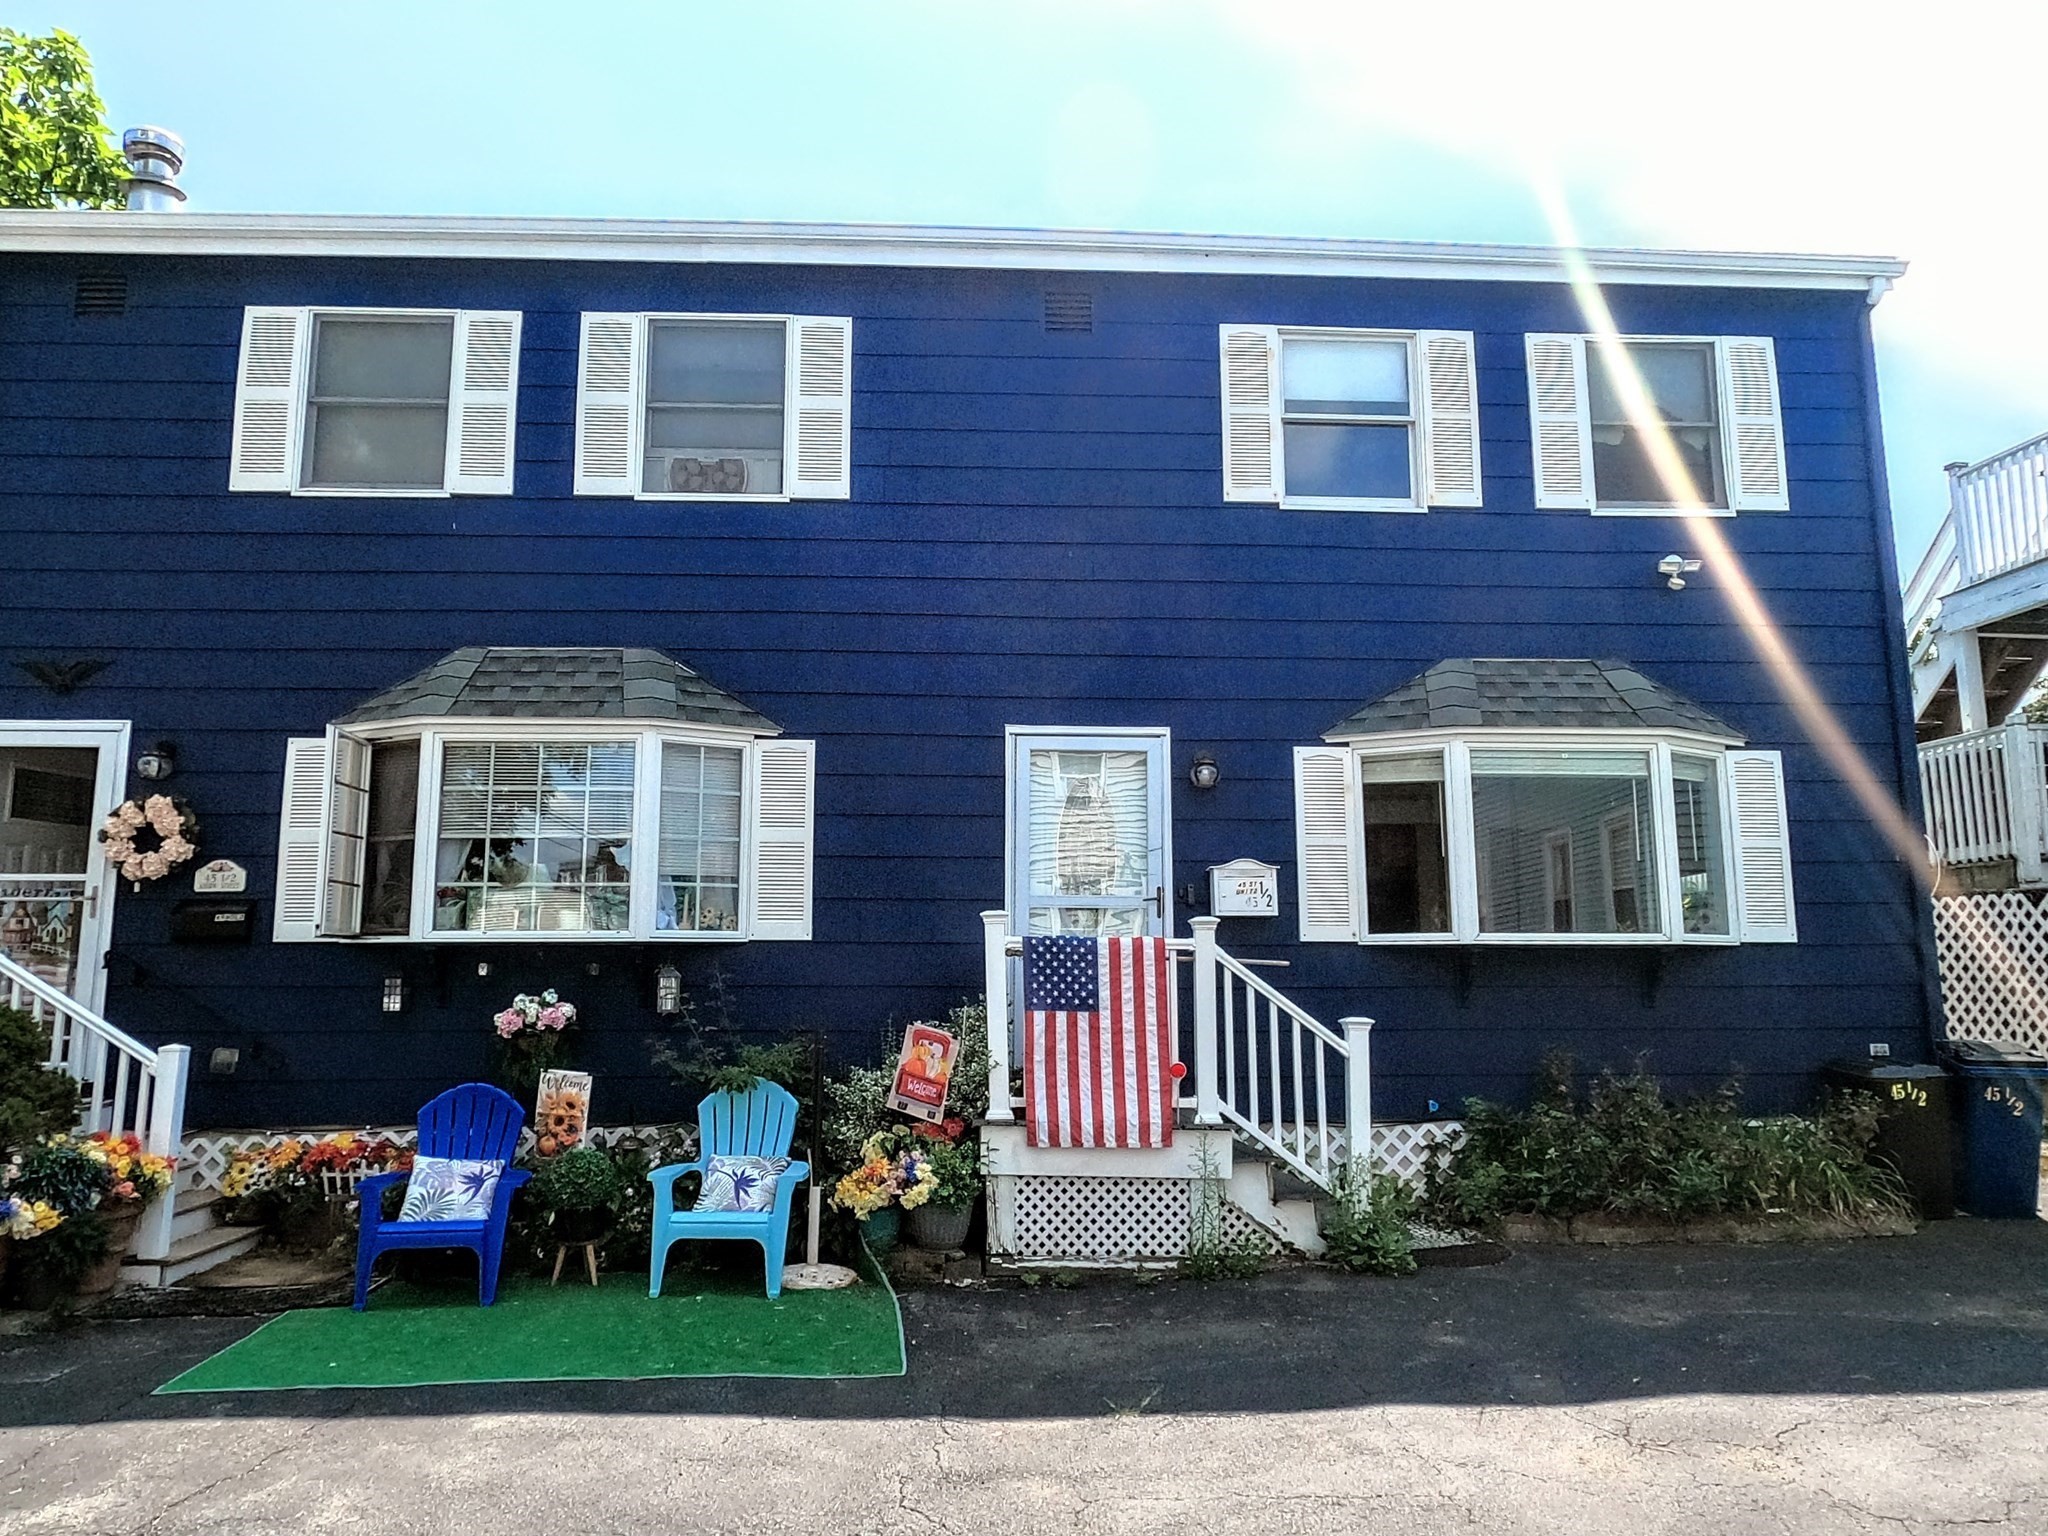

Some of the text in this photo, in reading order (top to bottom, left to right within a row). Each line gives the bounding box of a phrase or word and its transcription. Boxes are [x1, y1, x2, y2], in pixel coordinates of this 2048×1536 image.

[907, 1078, 937, 1098] Welcome
[1891, 1083, 1906, 1101] 45
[1983, 1086, 2001, 1102] 45
